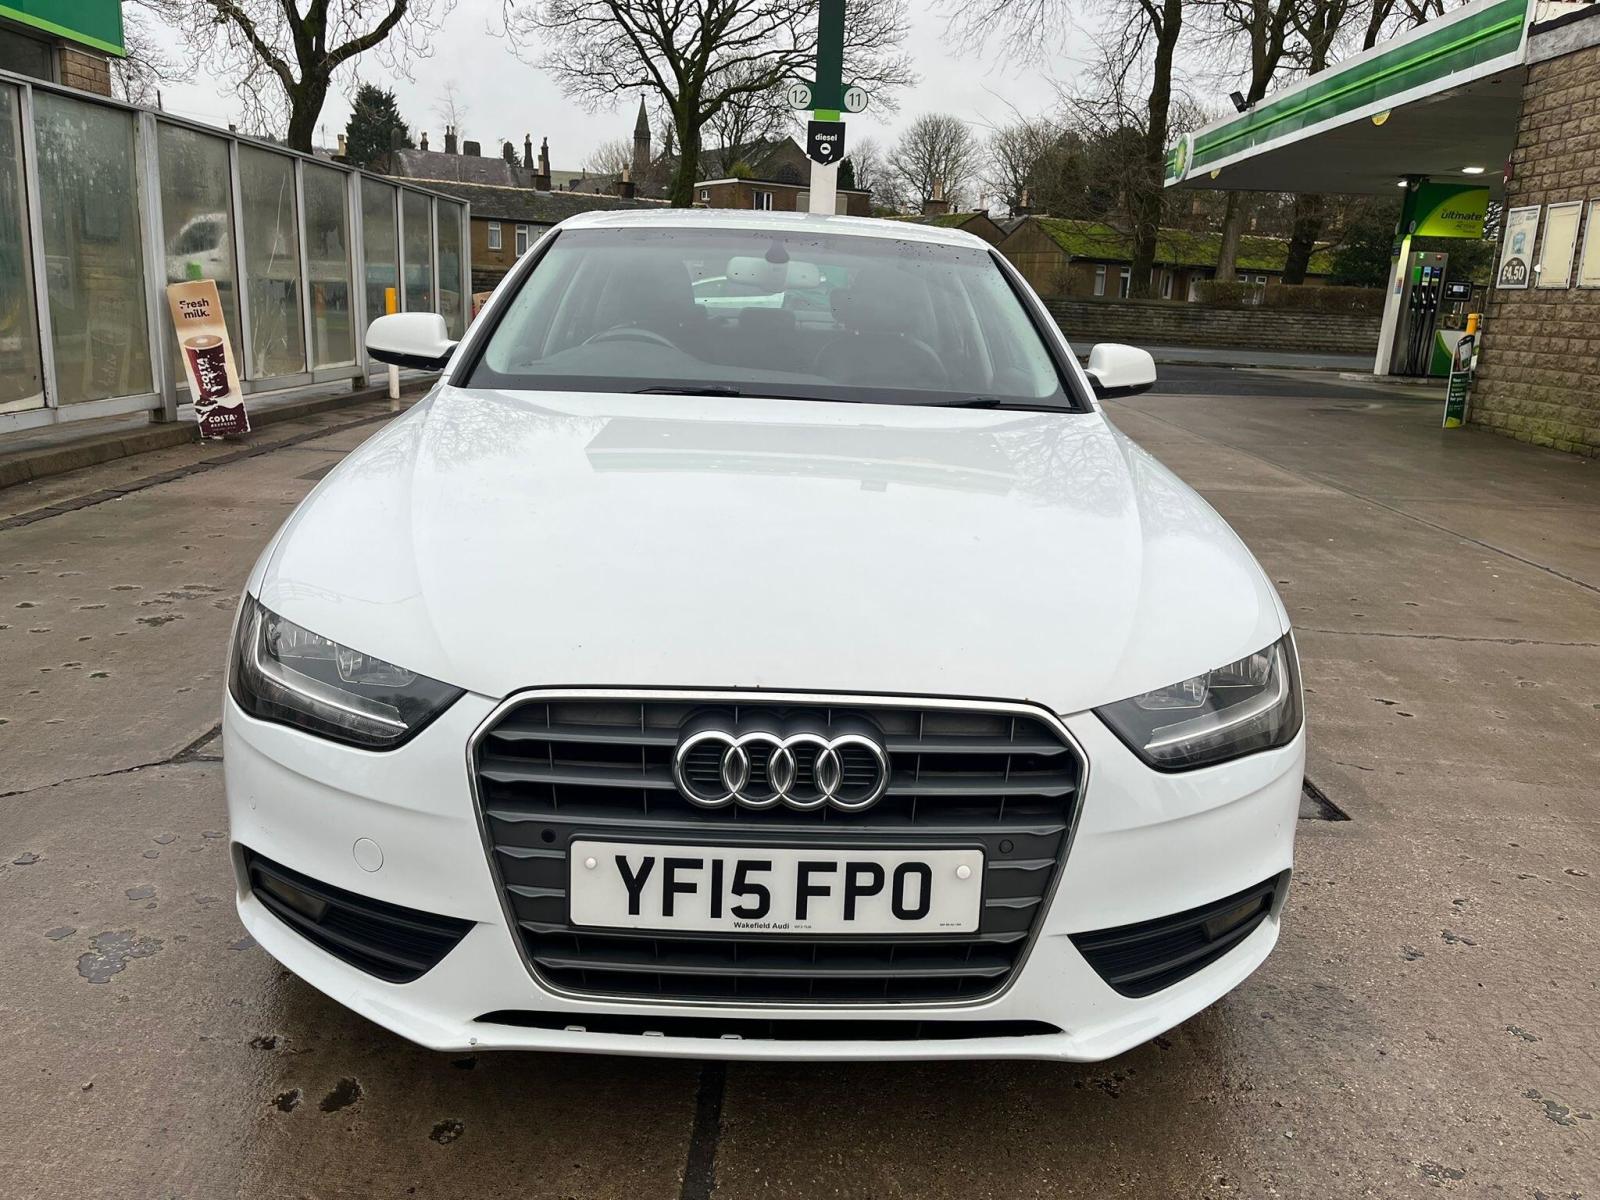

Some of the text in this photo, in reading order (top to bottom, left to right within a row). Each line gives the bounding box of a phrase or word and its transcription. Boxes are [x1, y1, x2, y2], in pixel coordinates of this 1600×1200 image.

[792, 90, 808, 104] 12
[849, 93, 862, 107] 11
[815, 133, 838, 142] diesel
[1440, 211, 1482, 221] ultimate
[1502, 265, 1525, 281] £4.50
[179, 298, 210, 310] Fresh
[184, 309, 210, 319] milk.
[208, 414, 236, 423] COSTA
[615, 855, 932, 920] YF15 FPO
[733, 921, 770, 930] Wakefield
[772, 922, 790, 930] Audi
